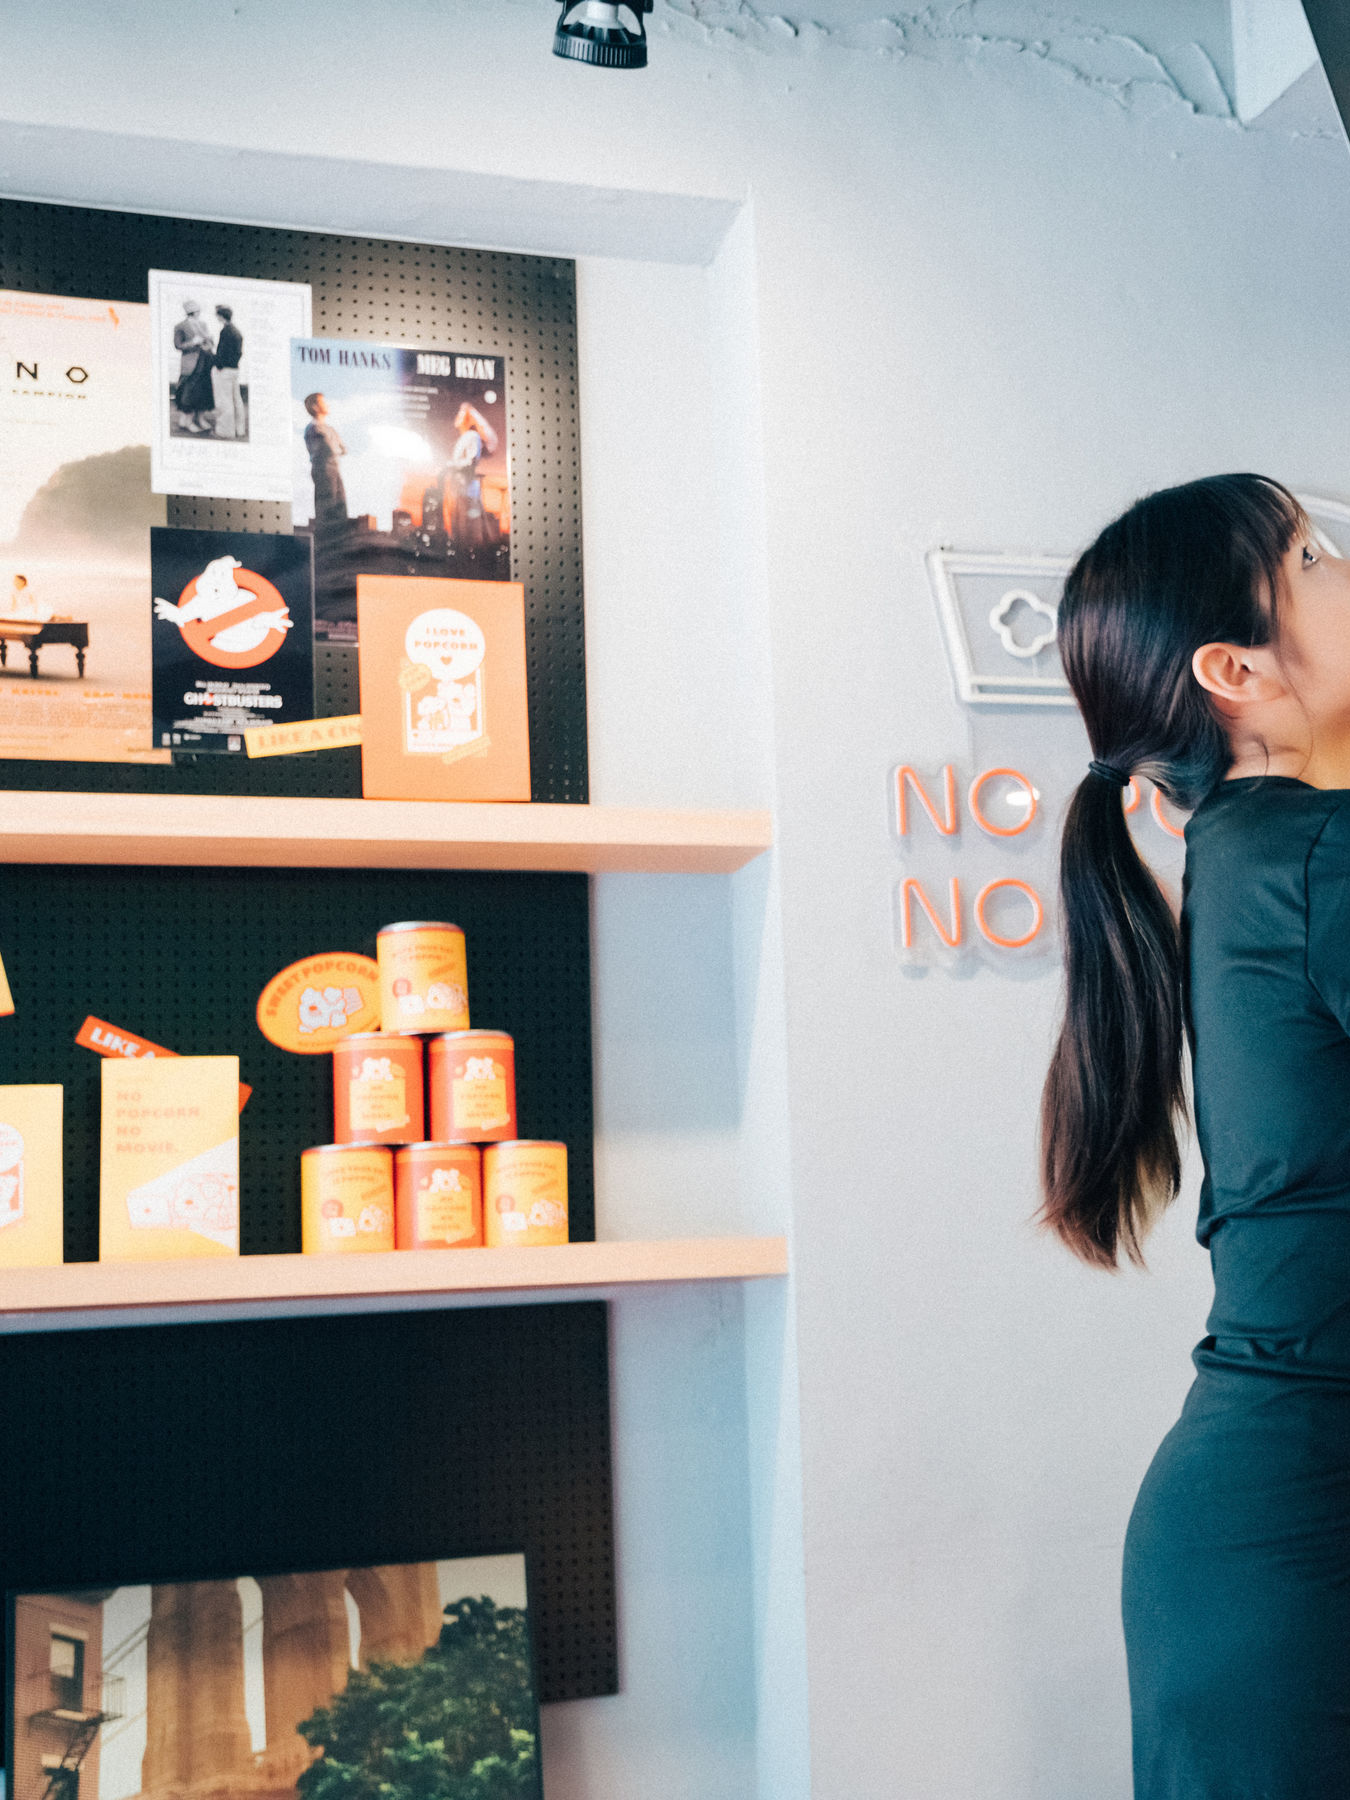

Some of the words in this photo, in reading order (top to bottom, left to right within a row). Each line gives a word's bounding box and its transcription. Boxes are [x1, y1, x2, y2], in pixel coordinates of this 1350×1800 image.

[298, 346, 331, 364] TOM
[339, 350, 392, 370] HANKS
[416, 353, 451, 377] MEG
[455, 356, 496, 381] RYAN
[433, 627, 466, 636] LOVE
[414, 640, 478, 650] POPCORN
[258, 731, 304, 748] LIKE
[310, 728, 323, 741] A
[894, 764, 1038, 837] NO
[900, 877, 1044, 948] NO
[302, 960, 379, 983] POPCORN
[90, 1027, 140, 1059] LIKE
[116, 1125, 142, 1137] NO
